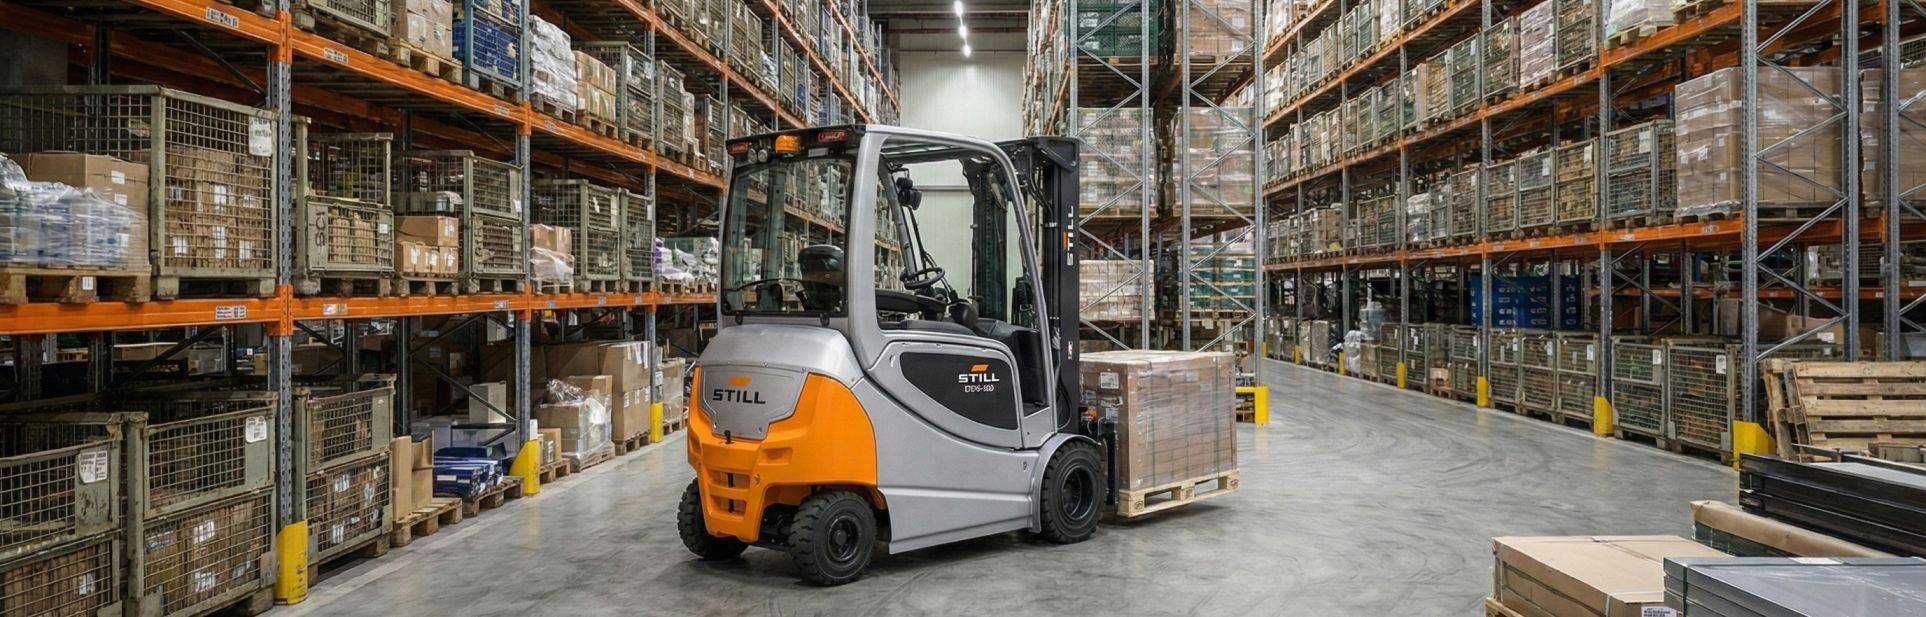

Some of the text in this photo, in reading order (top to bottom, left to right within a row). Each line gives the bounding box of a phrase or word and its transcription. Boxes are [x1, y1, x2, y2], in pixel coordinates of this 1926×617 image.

[1066, 205, 1074, 266] STILL
[958, 373, 1000, 383] STILL
[712, 388, 766, 405] STILL
